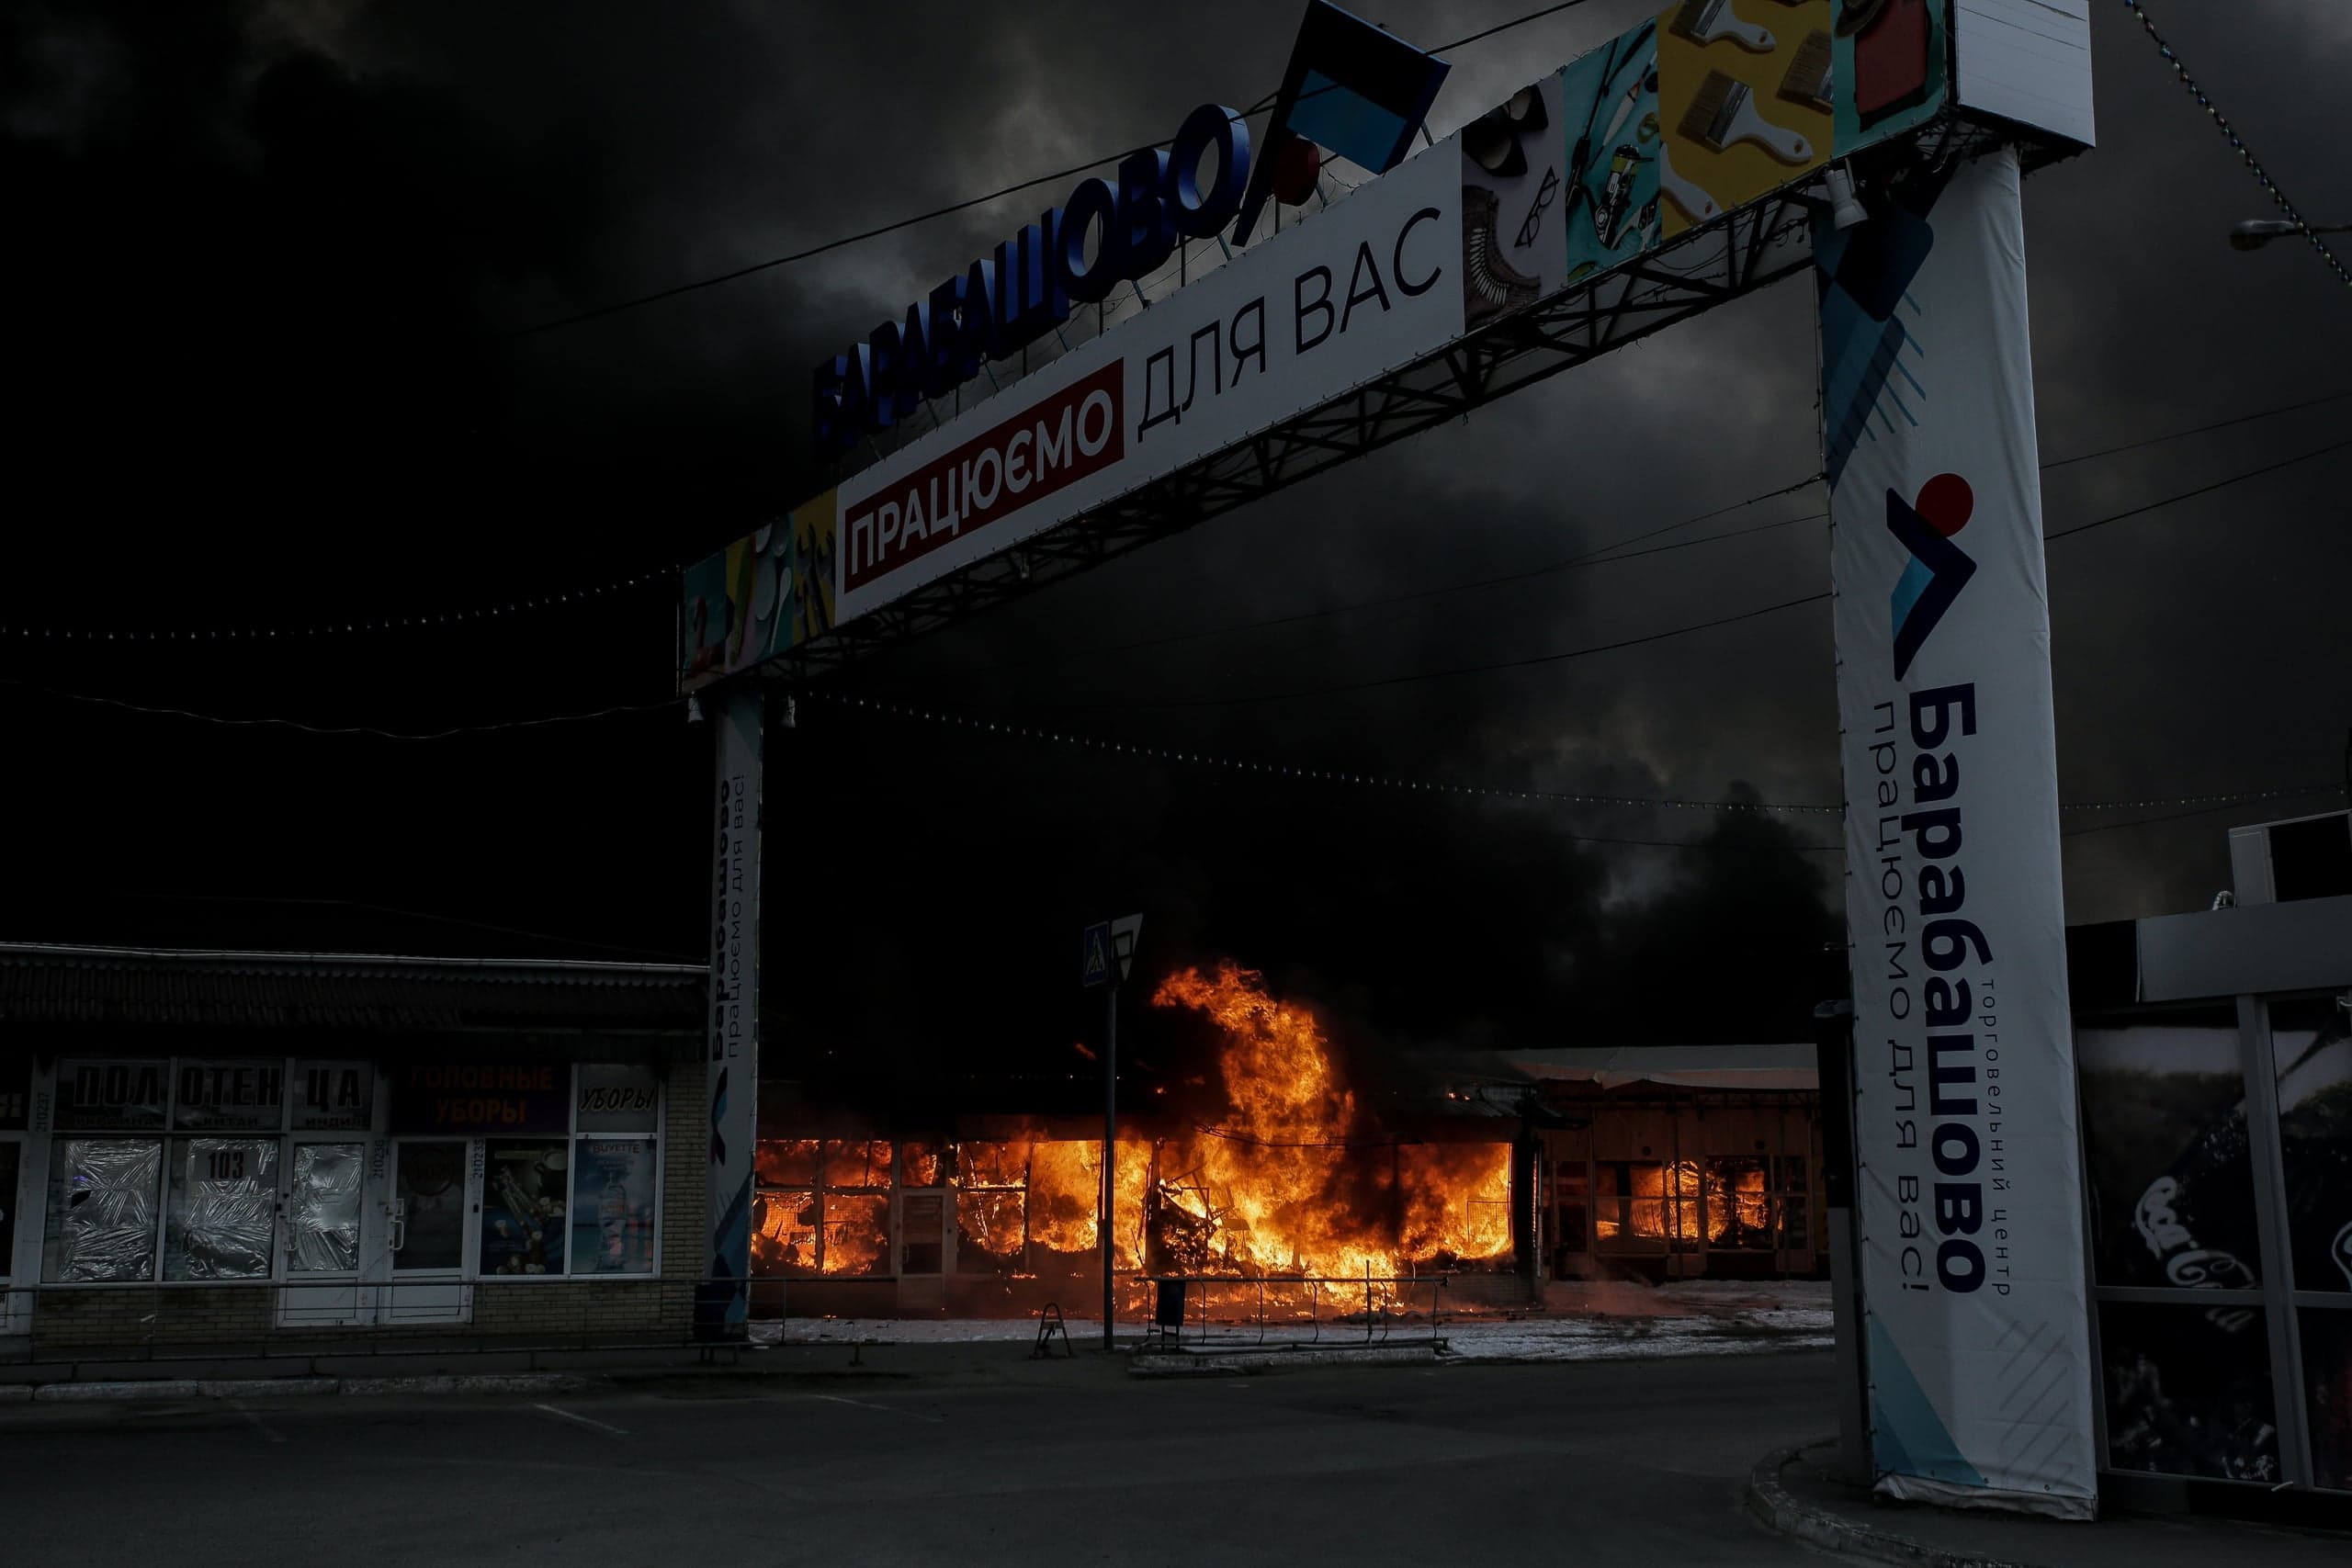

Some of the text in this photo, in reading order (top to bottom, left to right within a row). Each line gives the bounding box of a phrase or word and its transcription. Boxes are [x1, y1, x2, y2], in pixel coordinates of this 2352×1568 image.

[812, 104, 1250, 461] БАРАБАШОВО
[850, 208, 1442, 575] ПРАЦЮЄМО ДЛЯ ВАС
[713, 780, 729, 1061] Барабашово
[729, 773, 745, 1057] працюємо для вас!
[1870, 702, 1928, 1292] працюємо для вас!
[1902, 682, 1993, 1293] Барабашово
[208, 1151, 244, 1179] 103
[410, 1064, 559, 1091] ГОЛОВНЫЕ
[435, 1097, 529, 1124] УБОРЫ
[580, 1088, 657, 1111] УБОРЫ
[1978, 979, 2010, 1295] торговельний центр
